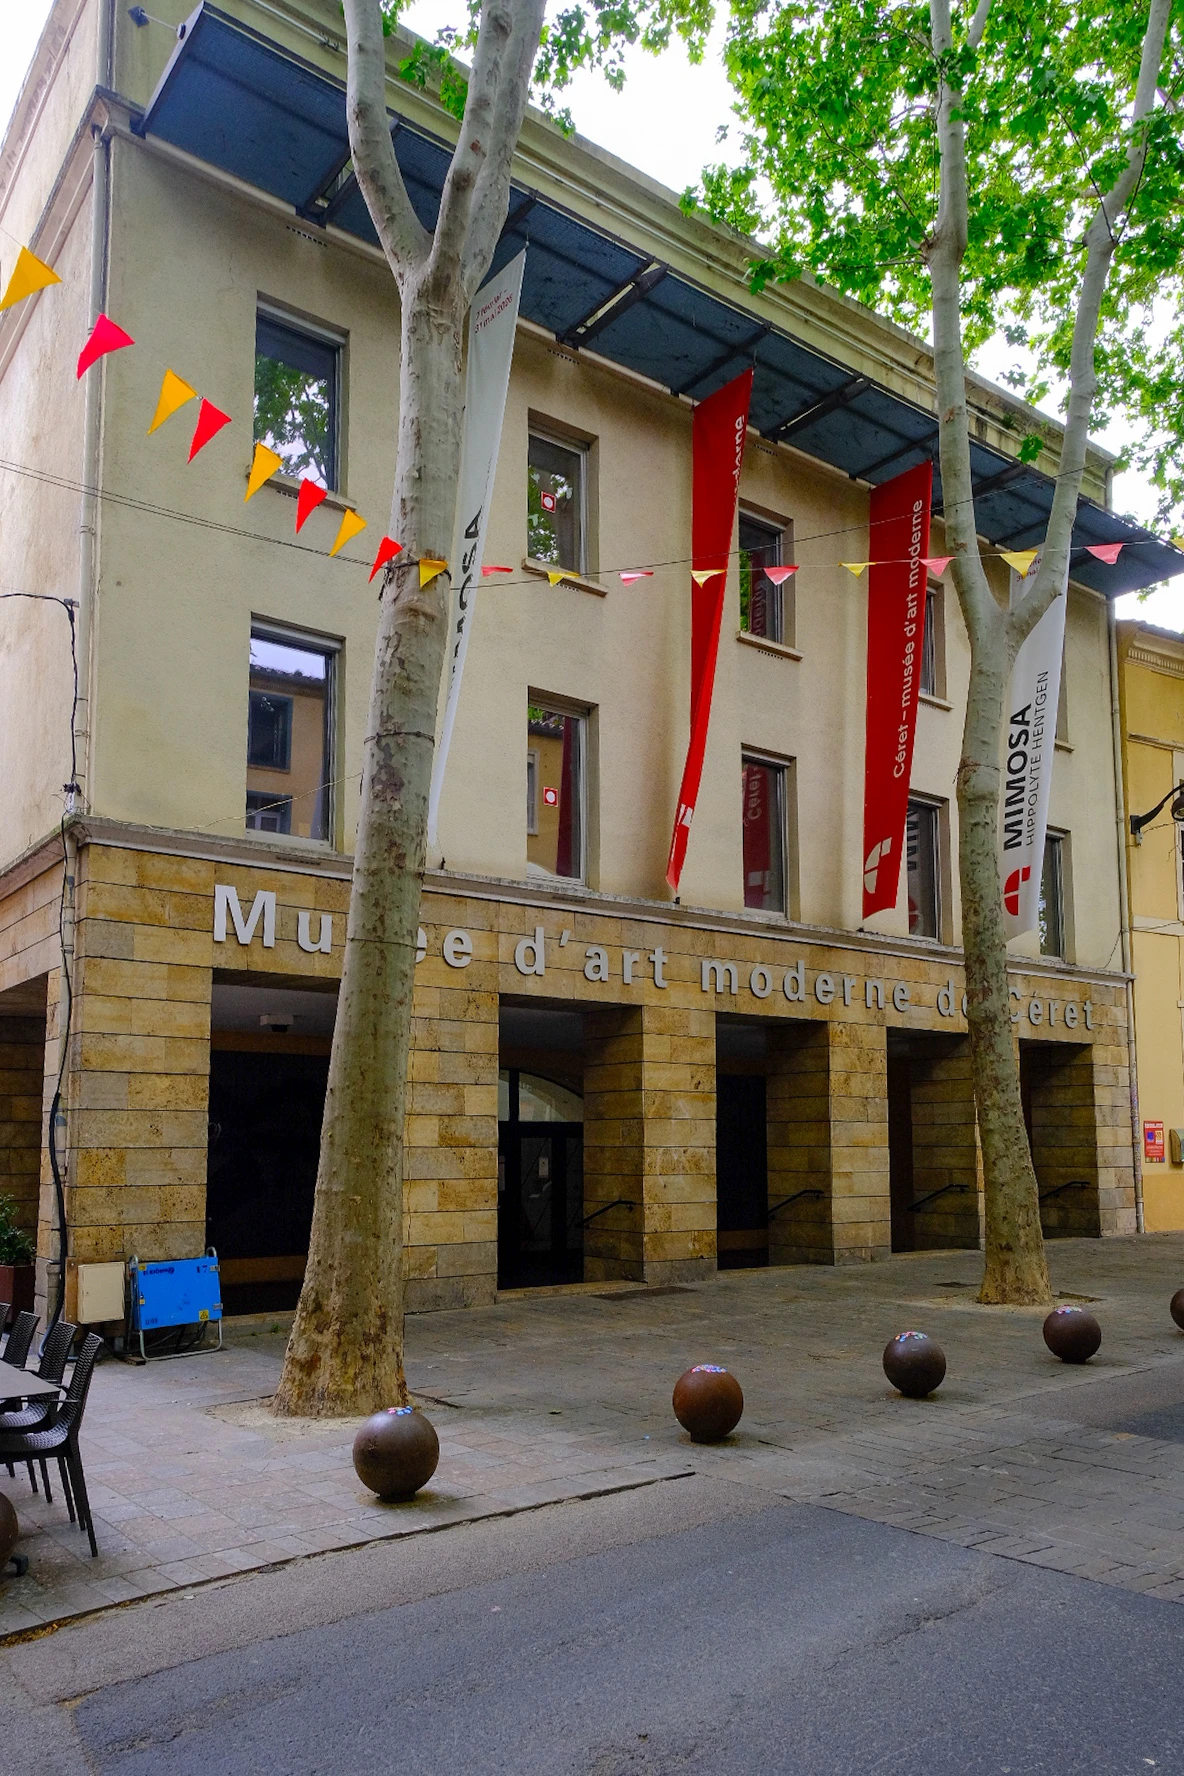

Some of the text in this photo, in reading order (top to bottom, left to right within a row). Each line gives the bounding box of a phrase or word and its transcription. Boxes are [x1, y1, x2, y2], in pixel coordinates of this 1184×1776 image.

[908, 499, 923, 588] moderne
[904, 592, 918, 637] d'art
[902, 640, 915, 708] musée
[893, 723, 909, 778] Céret
[1003, 702, 1032, 852] MIMOSA
[1026, 670, 1049, 847] HIPPOLYTE HENTGEN
[213, 884, 473, 968] Mue
[515, 926, 669, 989] d'art
[701, 959, 912, 1013] moderne
